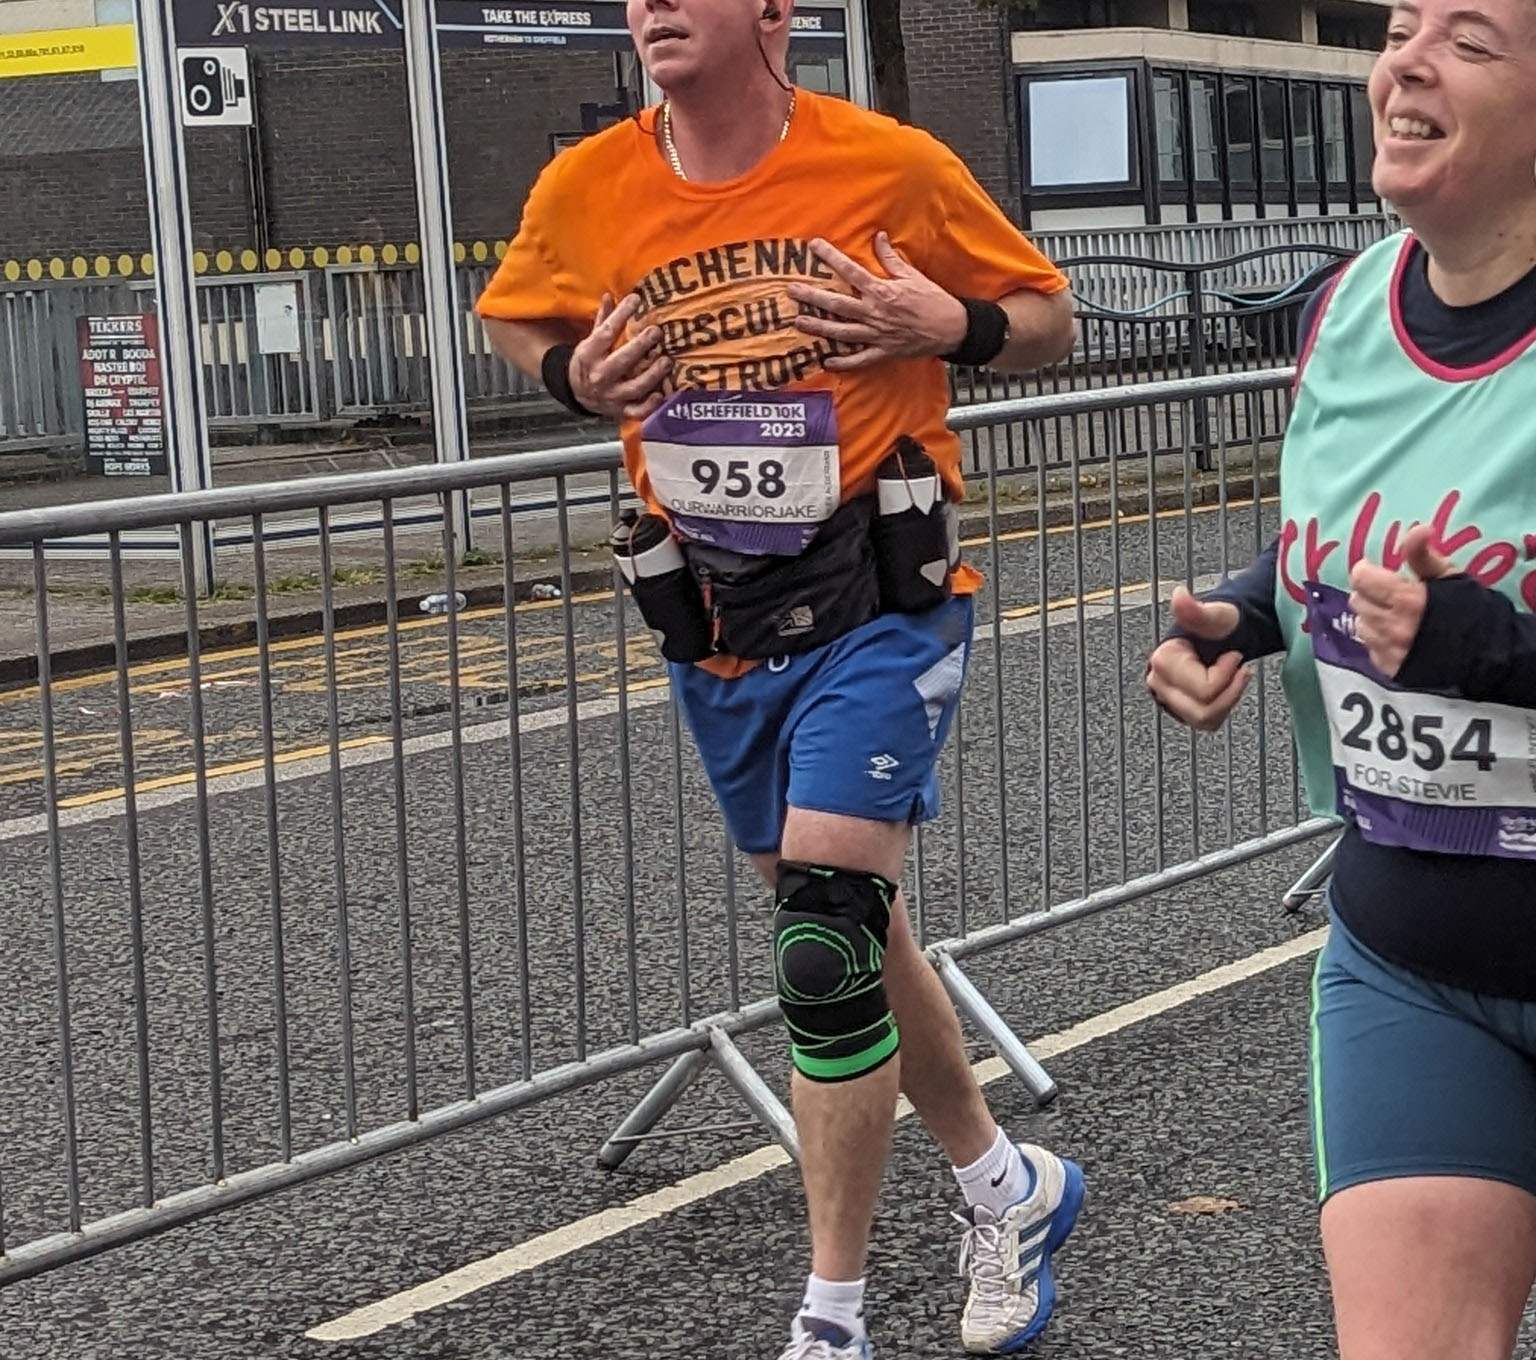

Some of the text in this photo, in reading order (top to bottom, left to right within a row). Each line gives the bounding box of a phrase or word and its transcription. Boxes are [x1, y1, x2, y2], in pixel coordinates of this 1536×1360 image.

[212, 1, 250, 36] X1
[329, 10, 383, 34] LINK
[482, 9, 591, 26] TAKE THE EXPRESS
[693, 405, 803, 419] SHEFFIELD 10K
[760, 423, 806, 437] 2023
[691, 459, 786, 499] 958
[1340, 692, 1497, 771] 2854
[1354, 763, 1477, 801] FOR STEVIE
